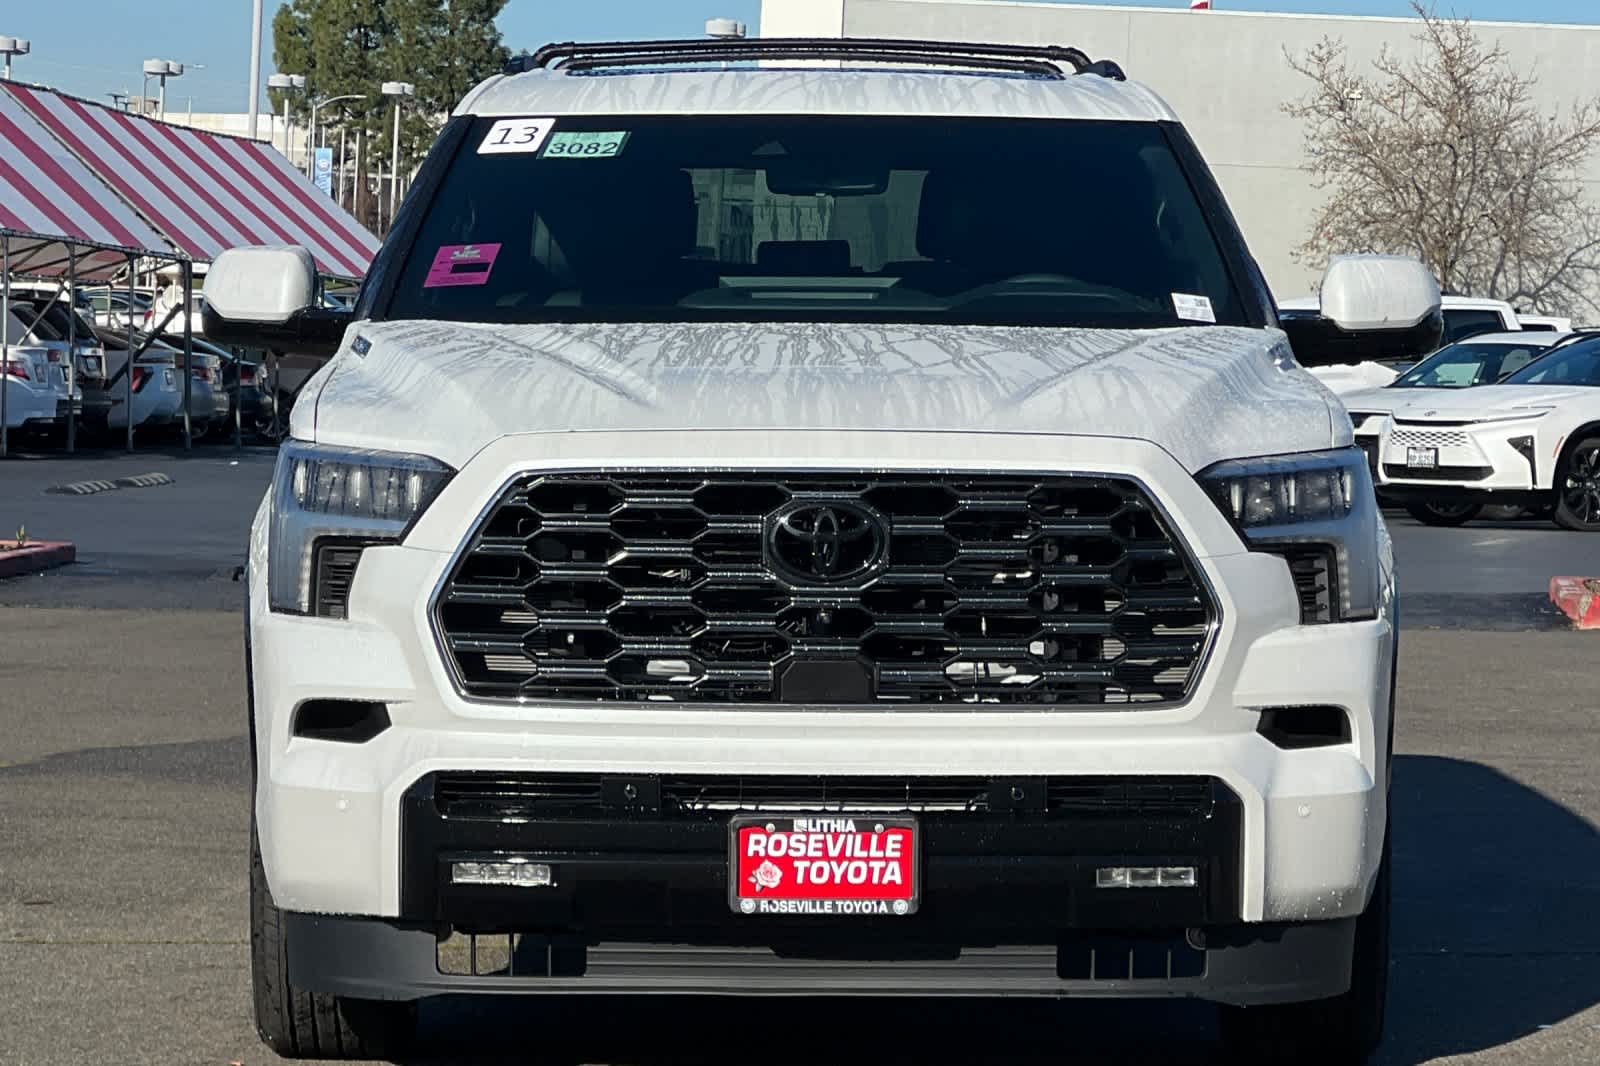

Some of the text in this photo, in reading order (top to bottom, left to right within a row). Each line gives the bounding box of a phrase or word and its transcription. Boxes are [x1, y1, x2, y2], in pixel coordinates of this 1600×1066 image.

[490, 126, 539, 145] 13
[549, 142, 618, 155] 3082
[808, 819, 856, 832] LITHIA
[747, 833, 903, 858] ROSEVILLE
[793, 860, 903, 885] TOYOTA
[760, 900, 888, 913] ROSEVILLE TOYOTA
